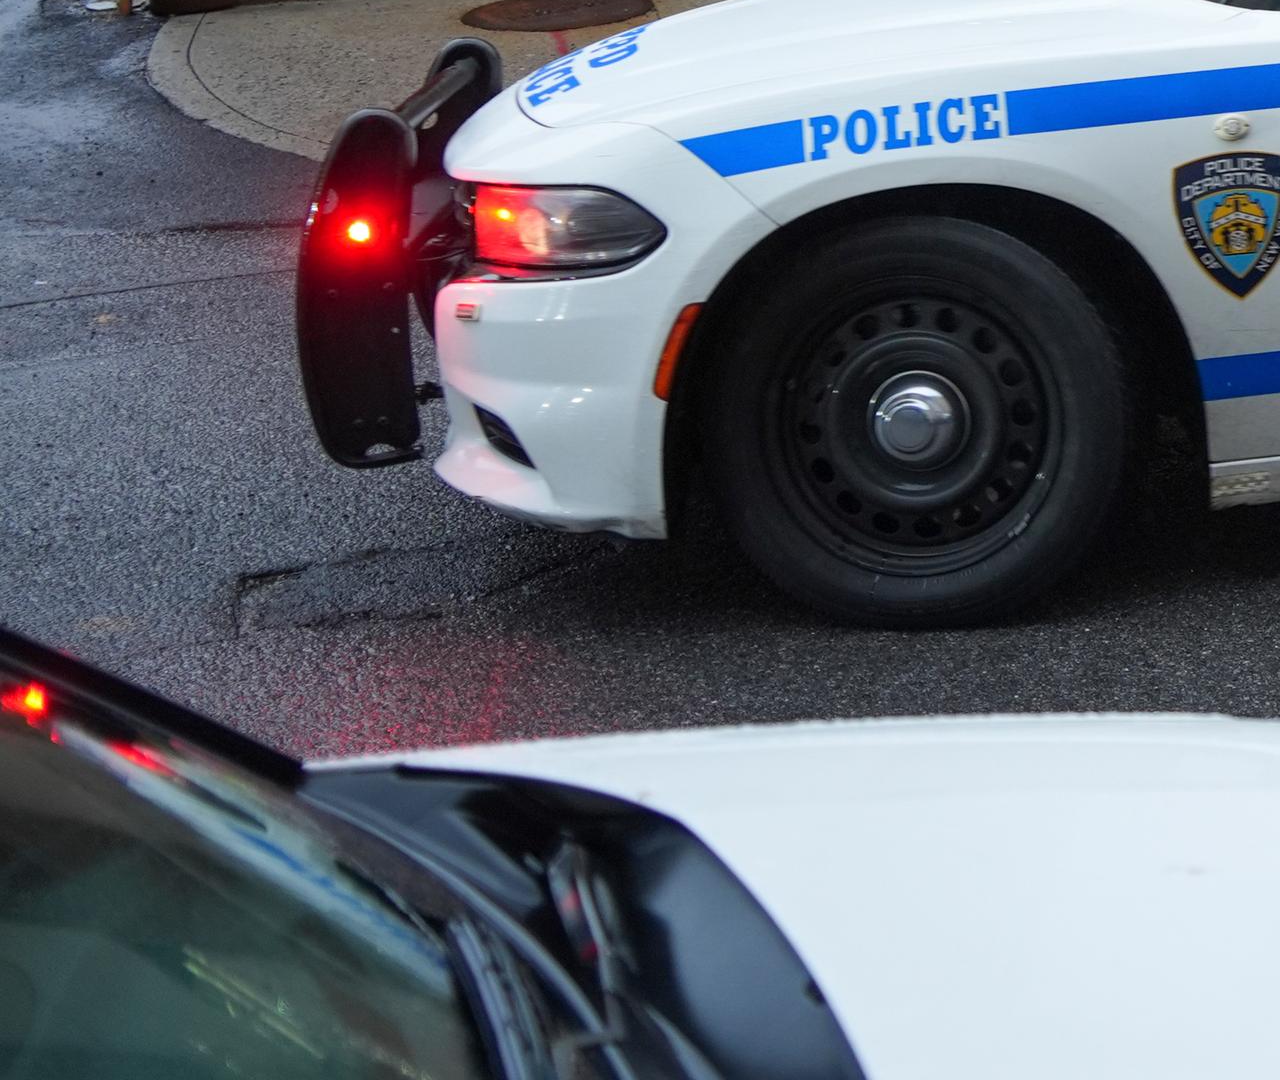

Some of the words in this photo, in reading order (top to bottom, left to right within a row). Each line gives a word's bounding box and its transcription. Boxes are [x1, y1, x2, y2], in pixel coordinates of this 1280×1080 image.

[807, 93, 1001, 162] POLICE
[1204, 158, 1265, 175] POLICE
[1199, 251, 1223, 271] OF
[1255, 242, 1280, 272] NEW
